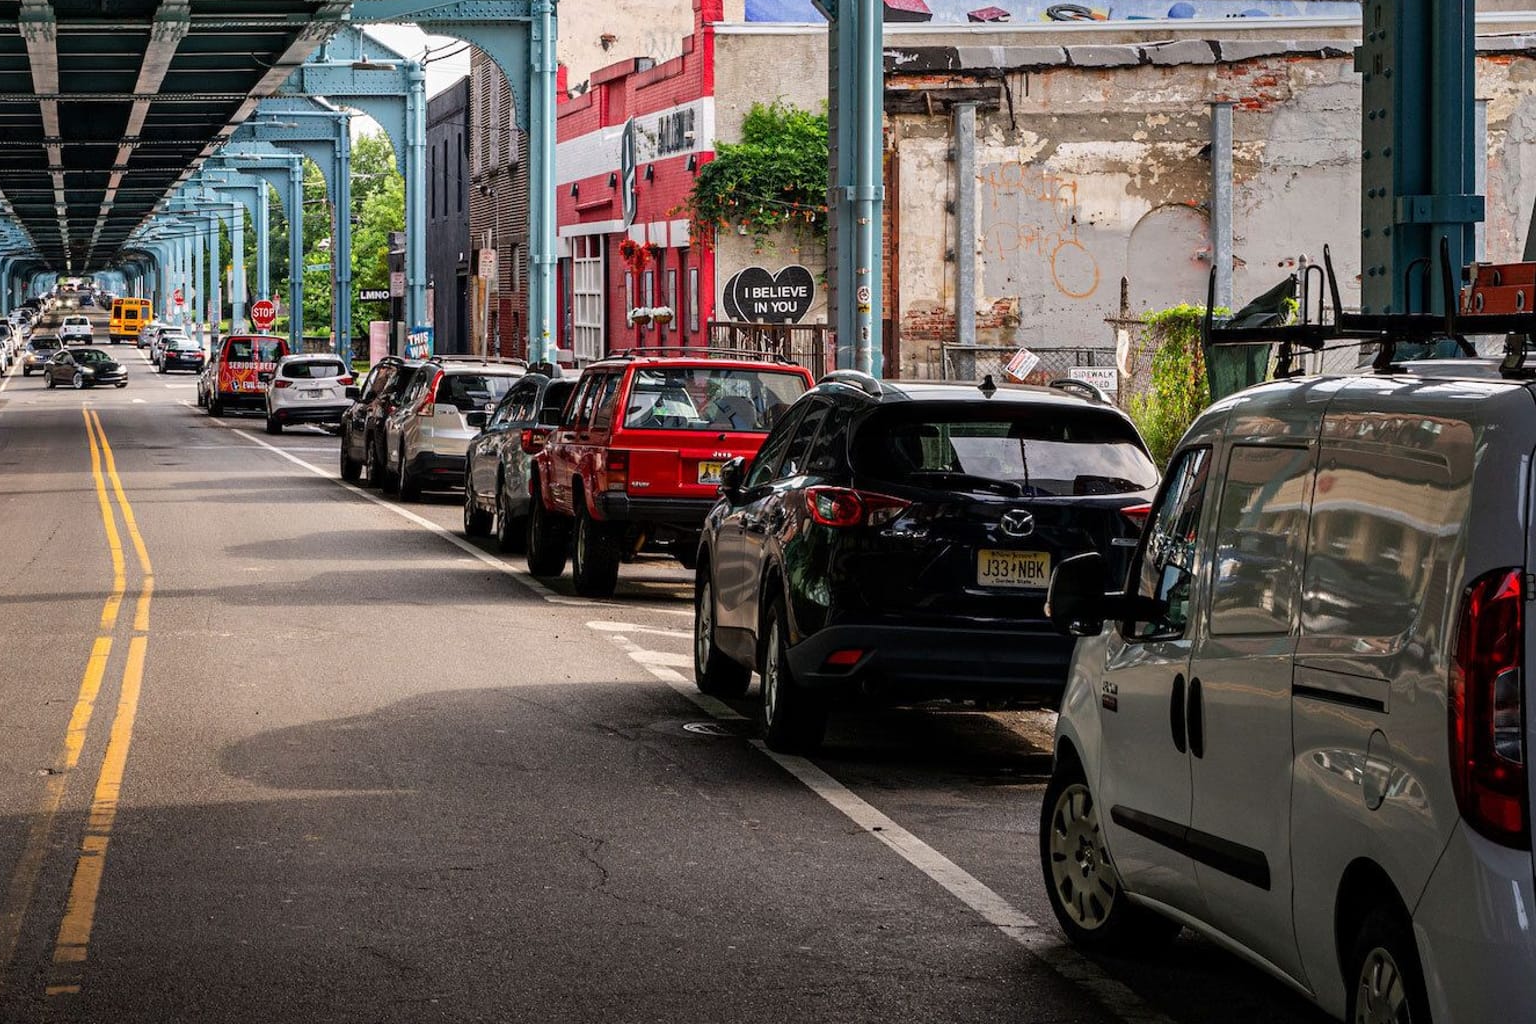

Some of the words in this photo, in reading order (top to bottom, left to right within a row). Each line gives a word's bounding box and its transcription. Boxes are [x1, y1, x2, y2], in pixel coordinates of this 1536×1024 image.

[360, 290, 389, 300] LMNO
[745, 287, 749, 298] I
[752, 286, 807, 298] BELIEVE
[253, 307, 274, 318] STOP
[754, 302, 767, 313] IN
[772, 301, 798, 313] YOU
[407, 331, 429, 345] THIS
[410, 342, 430, 358] WAY
[228, 361, 258, 370] SERIOUS
[1073, 369, 1114, 377] SIDEWALK
[243, 381, 256, 389] EVIL
[983, 559, 1009, 577] J33
[1018, 560, 1044, 578] NBK
